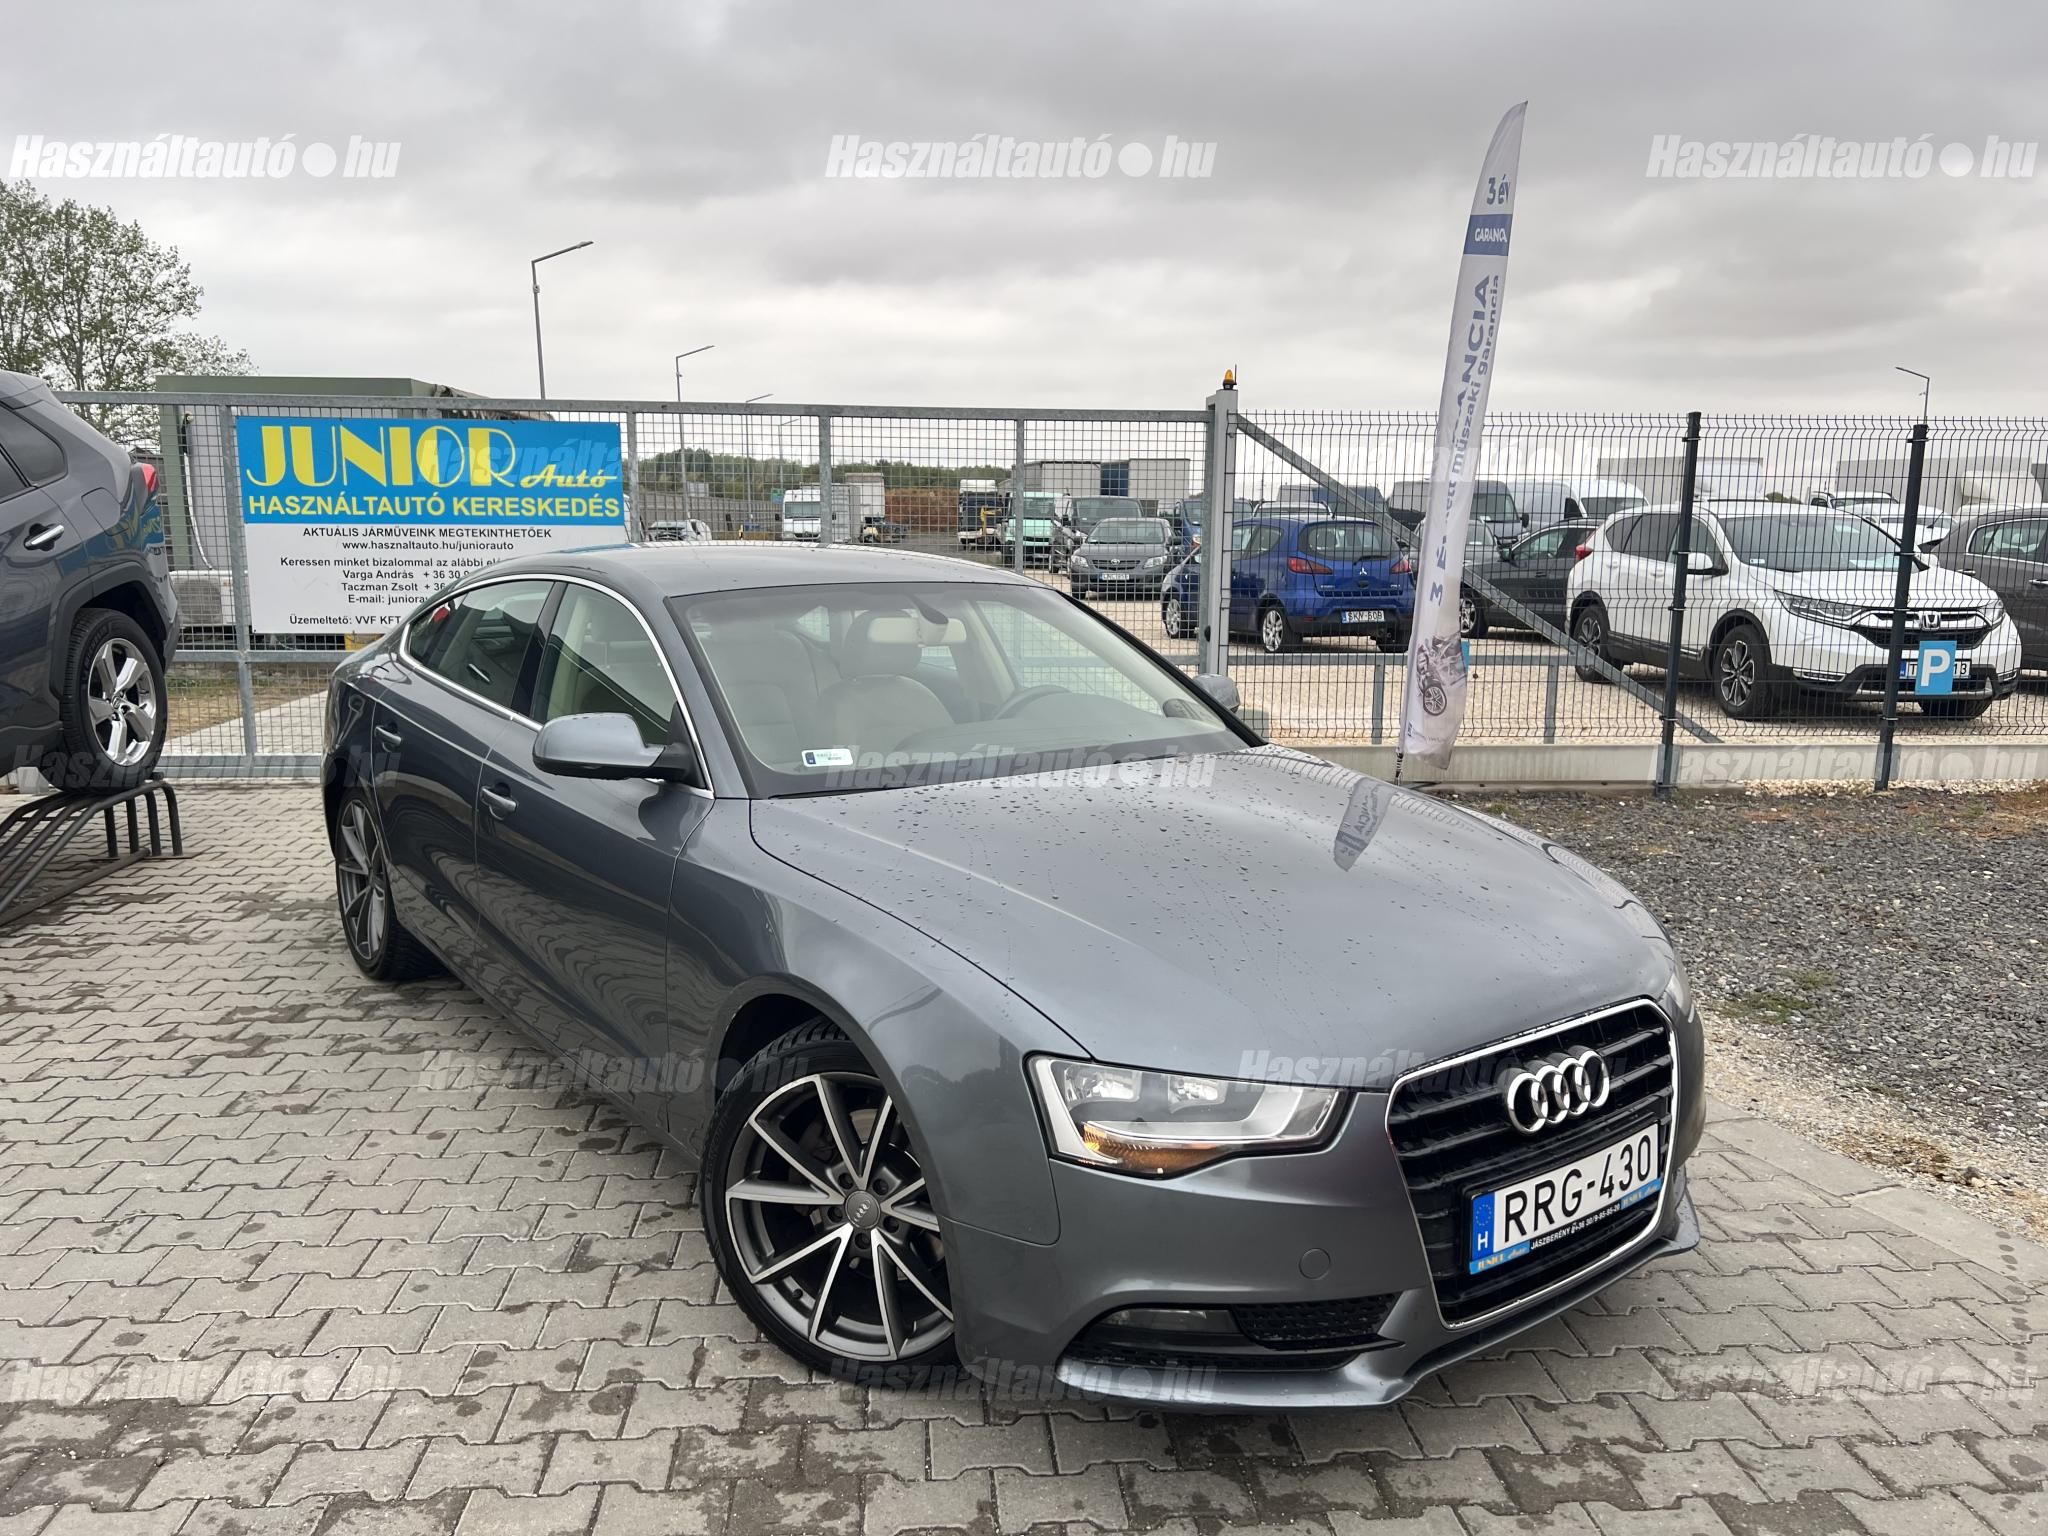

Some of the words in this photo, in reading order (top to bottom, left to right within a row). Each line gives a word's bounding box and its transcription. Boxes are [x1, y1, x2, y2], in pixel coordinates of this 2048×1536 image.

[1487, 177, 1496, 205] 3
[1478, 275, 1499, 375] garancia
[246, 425, 515, 488] JUNIOR
[520, 464, 618, 488] Autó
[249, 491, 445, 516] HASZNÁLTAUTÓ
[453, 493, 620, 517] KERESKEDÉS
[303, 526, 359, 537] AKTUÁLIS
[342, 541, 514, 551] www.hasznaltauto.hu/juniorauto
[280, 557, 331, 566] Keressen
[334, 557, 369, 567] minket
[372, 557, 433, 567] bizalommal
[451, 558, 483, 567] alábbi
[343, 570, 373, 581] Varga
[376, 569, 414, 579] András
[341, 582, 388, 591] Taczman
[391, 582, 418, 591] Zsolt
[348, 594, 385, 604] E-mail:
[355, 615, 376, 624] VVF
[1921, 649, 1951, 687] P
[1504, 1134, 1651, 1243] RRG-430
[1477, 1231, 1489, 1251] H
